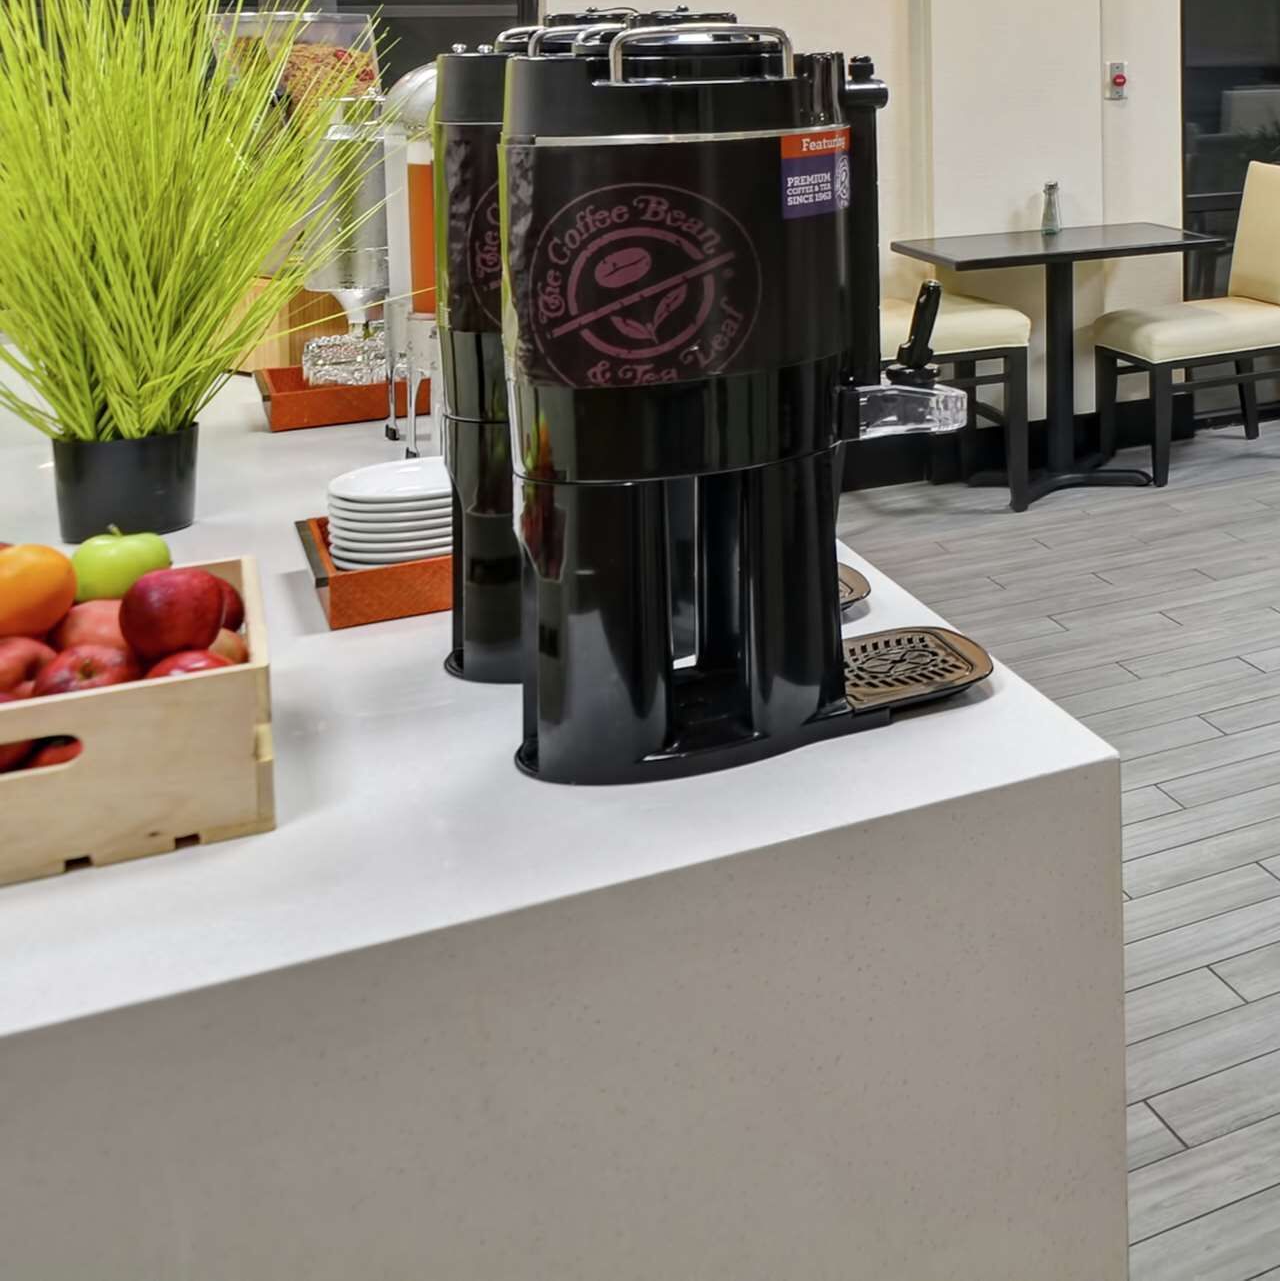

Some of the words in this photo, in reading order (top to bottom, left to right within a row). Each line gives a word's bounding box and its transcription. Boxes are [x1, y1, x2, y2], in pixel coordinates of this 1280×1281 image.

[787, 172, 832, 187] PREMIUM
[787, 185, 814, 195] COFFEE
[787, 196, 814, 206] SINCE
[547, 204, 631, 265] Coffee
[632, 195, 722, 255] Bean
[538, 269, 565, 324] The
[587, 360, 611, 384] &
[618, 364, 679, 385] Tea
[679, 296, 745, 367] Leaf
